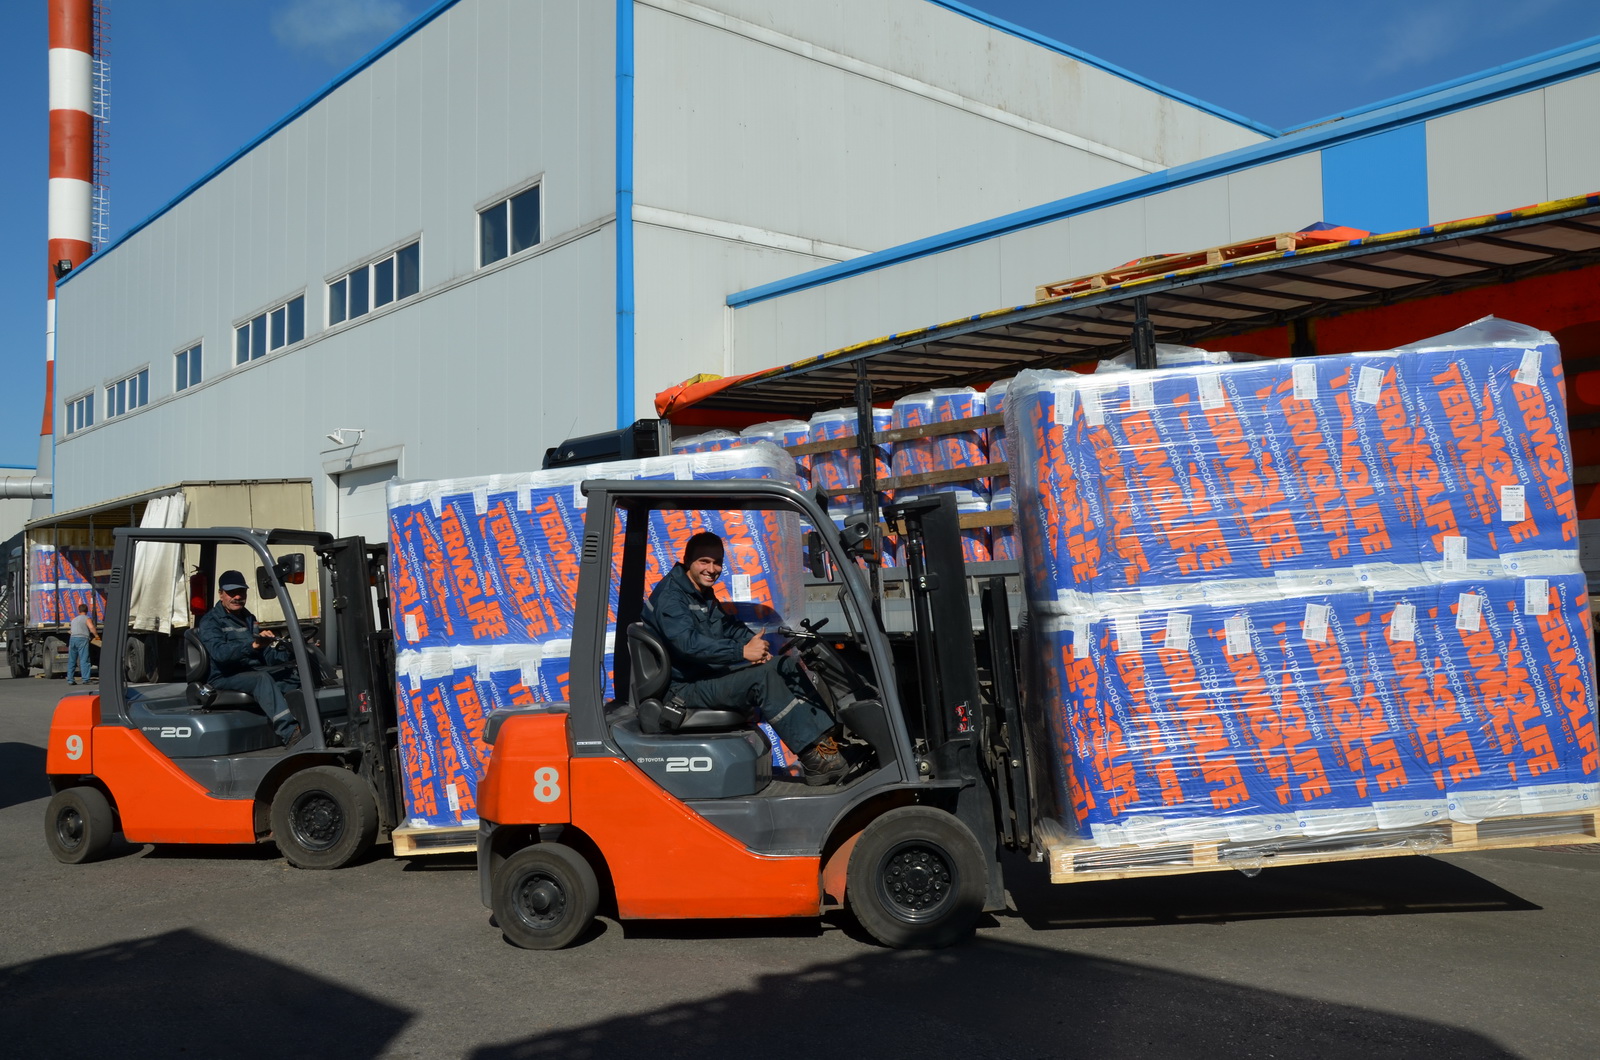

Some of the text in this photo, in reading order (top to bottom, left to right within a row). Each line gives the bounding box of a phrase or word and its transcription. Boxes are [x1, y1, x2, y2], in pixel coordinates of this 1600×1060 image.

[1119, 399, 1200, 576] ERMOLIFE
[1276, 375, 1350, 560] ERMOLIFE
[1422, 413, 1457, 494] профессионал
[1510, 371, 1578, 542] ERMOLIFE
[453, 500, 471, 536] изоляция
[646, 521, 670, 576] профессиона
[745, 514, 771, 574] профессионал
[438, 504, 493, 640] TERMOLIFE
[486, 501, 549, 639] TERMOLIFE
[1518, 637, 1554, 718] профессионал
[65, 735, 83, 761] 9
[160, 726, 192, 738] 20
[666, 757, 713, 772] 20
[533, 767, 561, 802] 8
